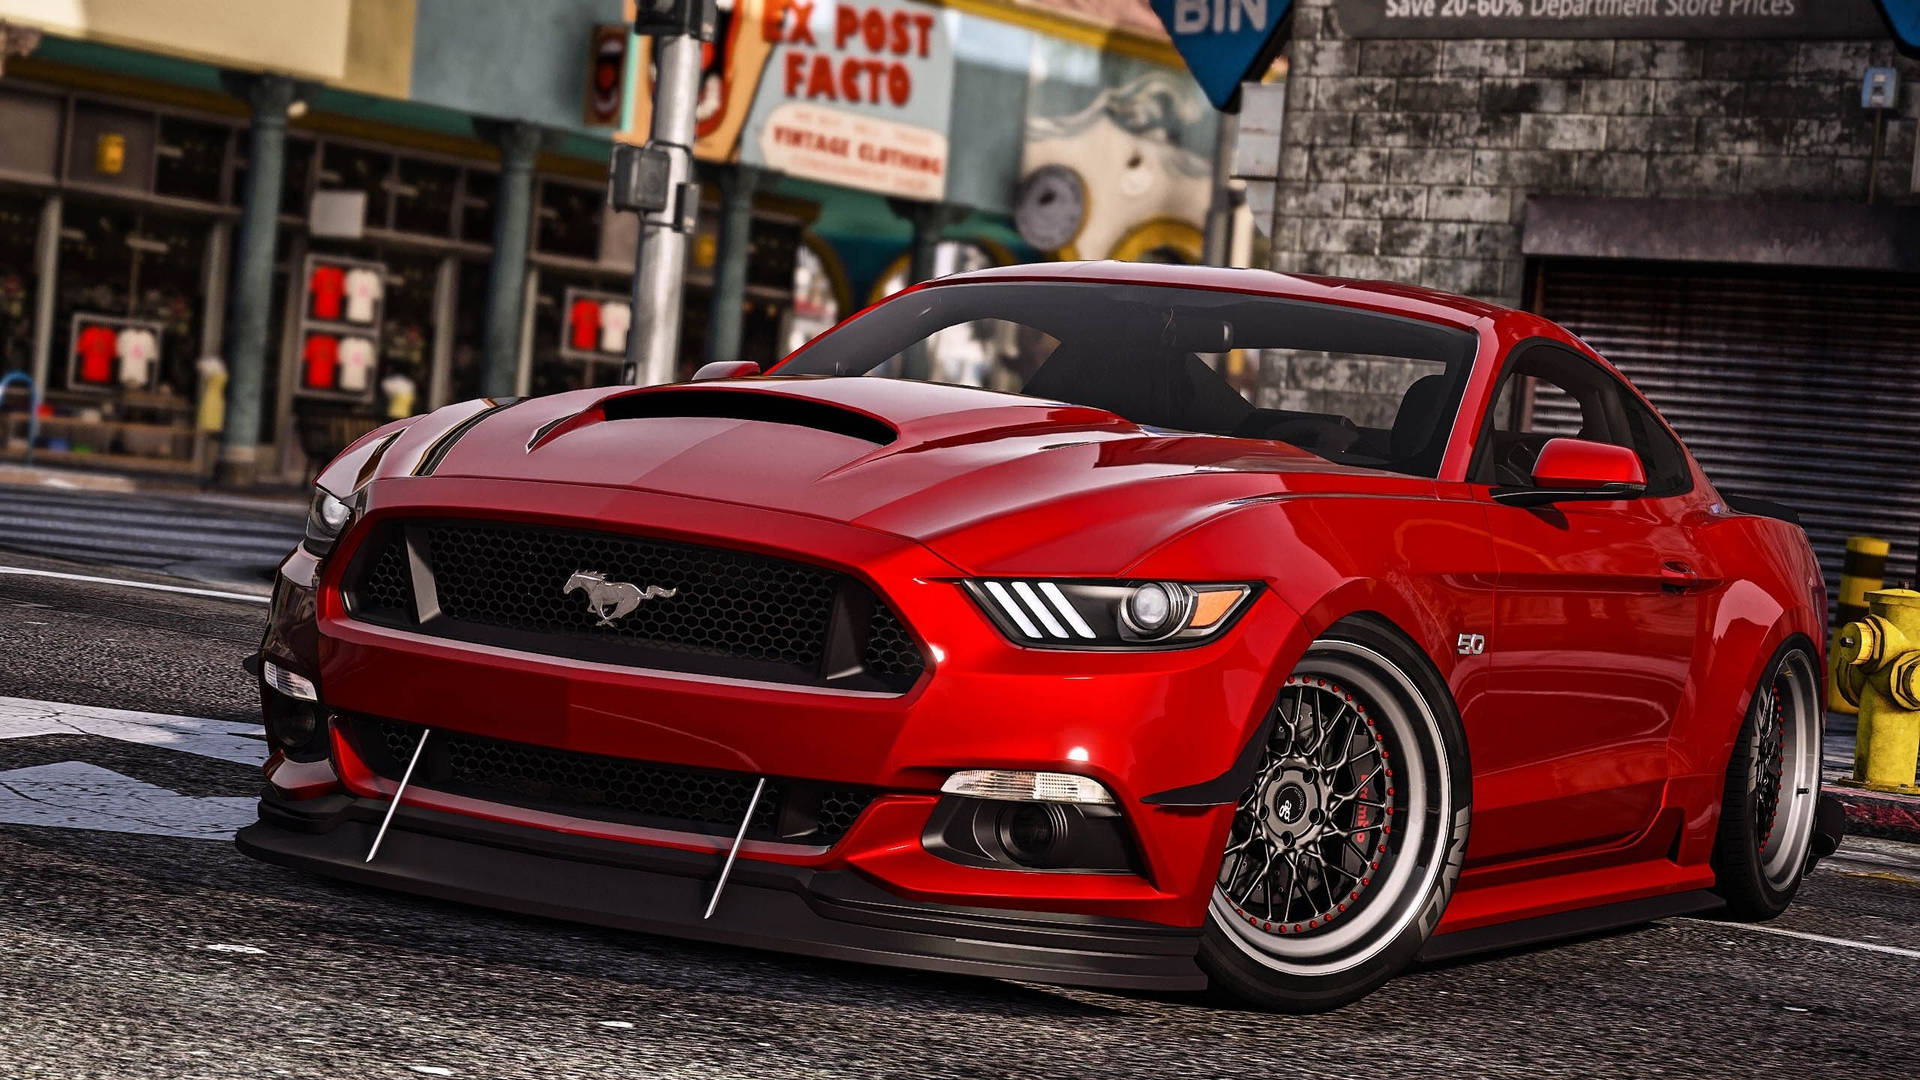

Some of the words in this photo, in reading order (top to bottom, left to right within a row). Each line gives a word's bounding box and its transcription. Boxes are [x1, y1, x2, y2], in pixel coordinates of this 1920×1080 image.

[763, 0, 816, 46] EX
[835, 4, 935, 59] POST
[1174, 0, 1268, 34] BIN
[1385, 0, 1434, 17] Save
[1440, 0, 1523, 17] 20-60%
[1530, 0, 1657, 19] Department
[1664, 0, 1721, 16] Store
[1729, 0, 1795, 16] Prices
[784, 52, 911, 107] FACTO
[773, 125, 850, 159] VINTAGE
[857, 142, 943, 176] CLOTHING
